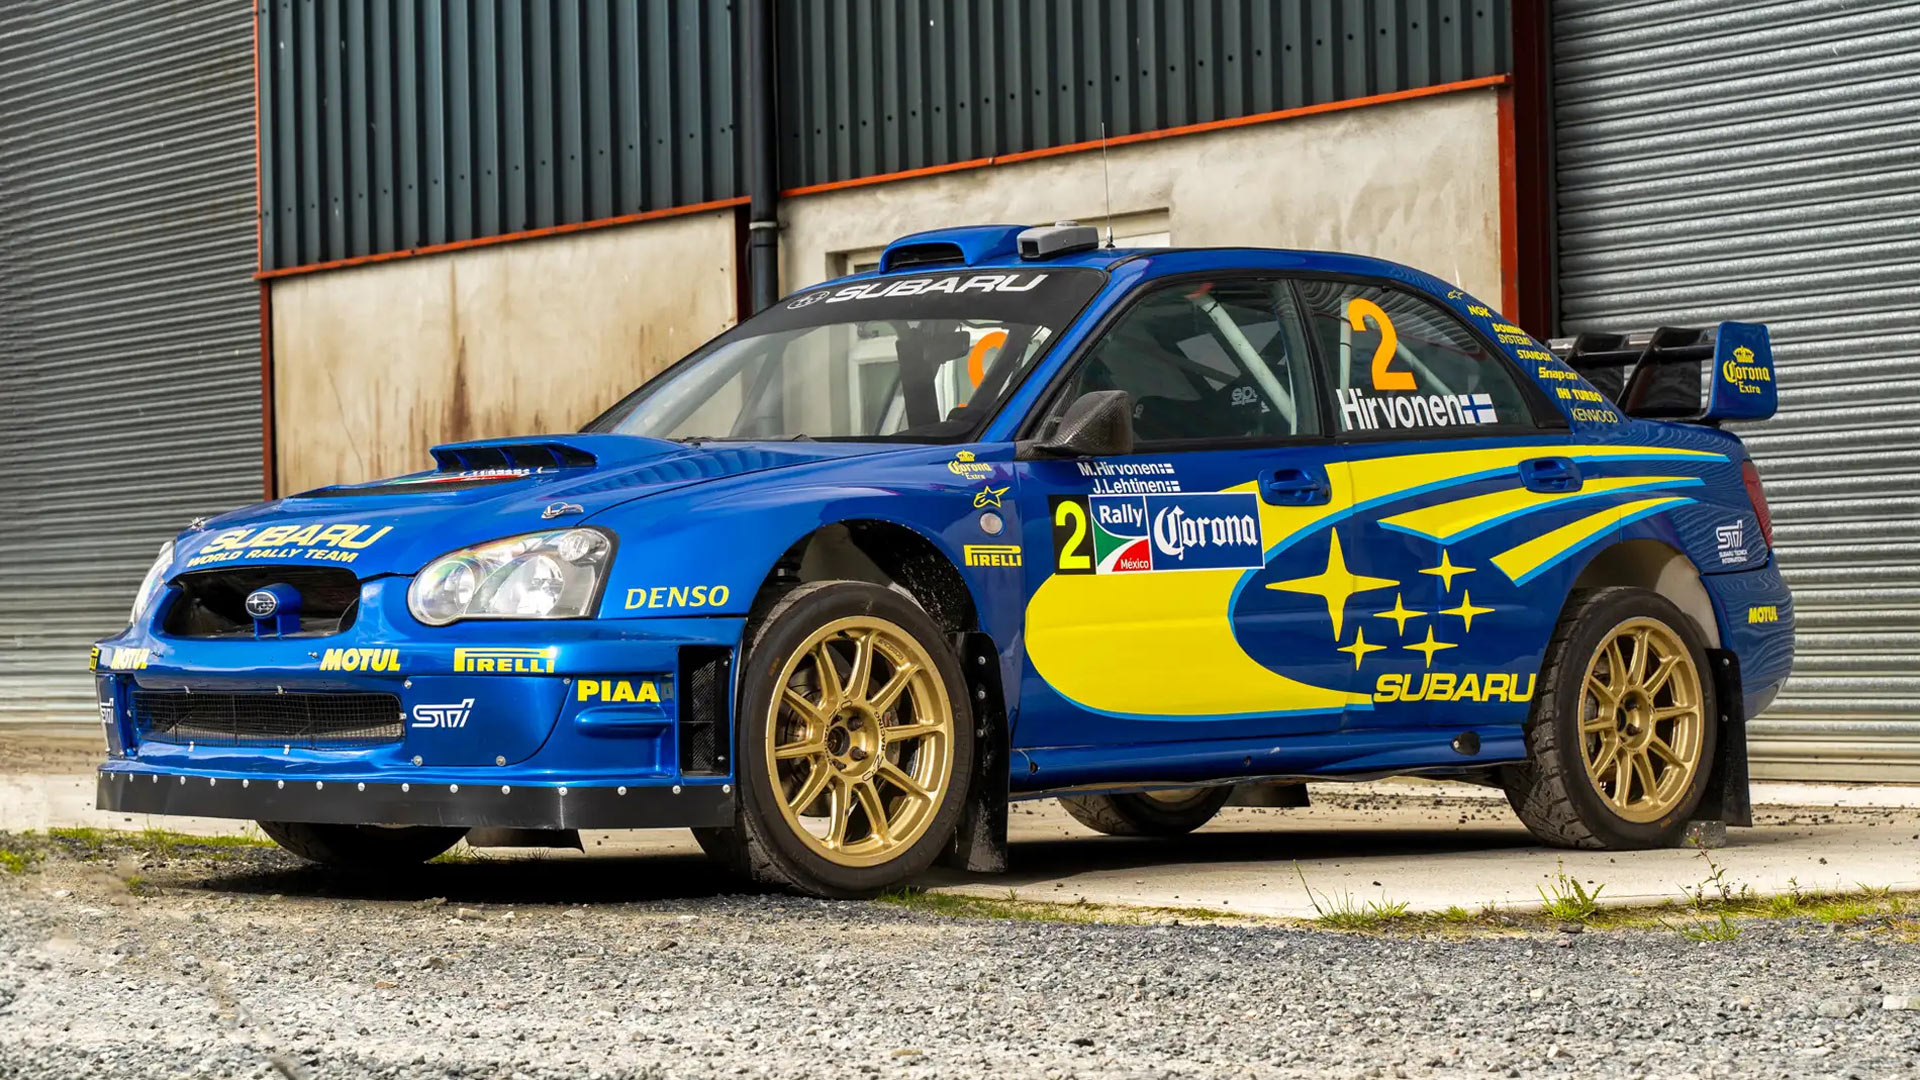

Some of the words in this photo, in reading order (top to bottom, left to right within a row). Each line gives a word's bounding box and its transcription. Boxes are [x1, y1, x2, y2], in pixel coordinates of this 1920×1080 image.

[825, 273, 1049, 304] SUBARU
[1467, 304, 1493, 318] NGK
[1347, 298, 1417, 391] 2
[1538, 366, 1578, 381] Snap-on
[1723, 360, 1771, 385] Corona
[1556, 387, 1572, 400] IHI
[1572, 389, 1604, 403] TURBO
[1739, 381, 1762, 394] Extra
[1335, 388, 1465, 431] Hirvonen
[1570, 408, 1618, 424] KENWOOD
[947, 460, 993, 477] Corona
[1077, 461, 1160, 476] M.Hirvonen
[1093, 478, 1167, 494] J.Lehtinen
[1098, 503, 1144, 528] Rally
[200, 524, 394, 554] SUBARU
[1055, 500, 1091, 569] 2
[1153, 505, 1258, 561] Corona
[187, 551, 243, 568] WORLD
[245, 549, 303, 559] RALLY
[304, 549, 359, 563] TEAM
[963, 545, 1022, 567] PIRELLI
[1120, 558, 1149, 570] México
[625, 585, 729, 610] DENSO
[1748, 605, 1778, 624] MOTUL
[319, 648, 401, 671] MOTUL
[454, 647, 557, 673] PIRELLI
[578, 680, 661, 702] PIAA
[1374, 673, 1537, 703] SUBARU
